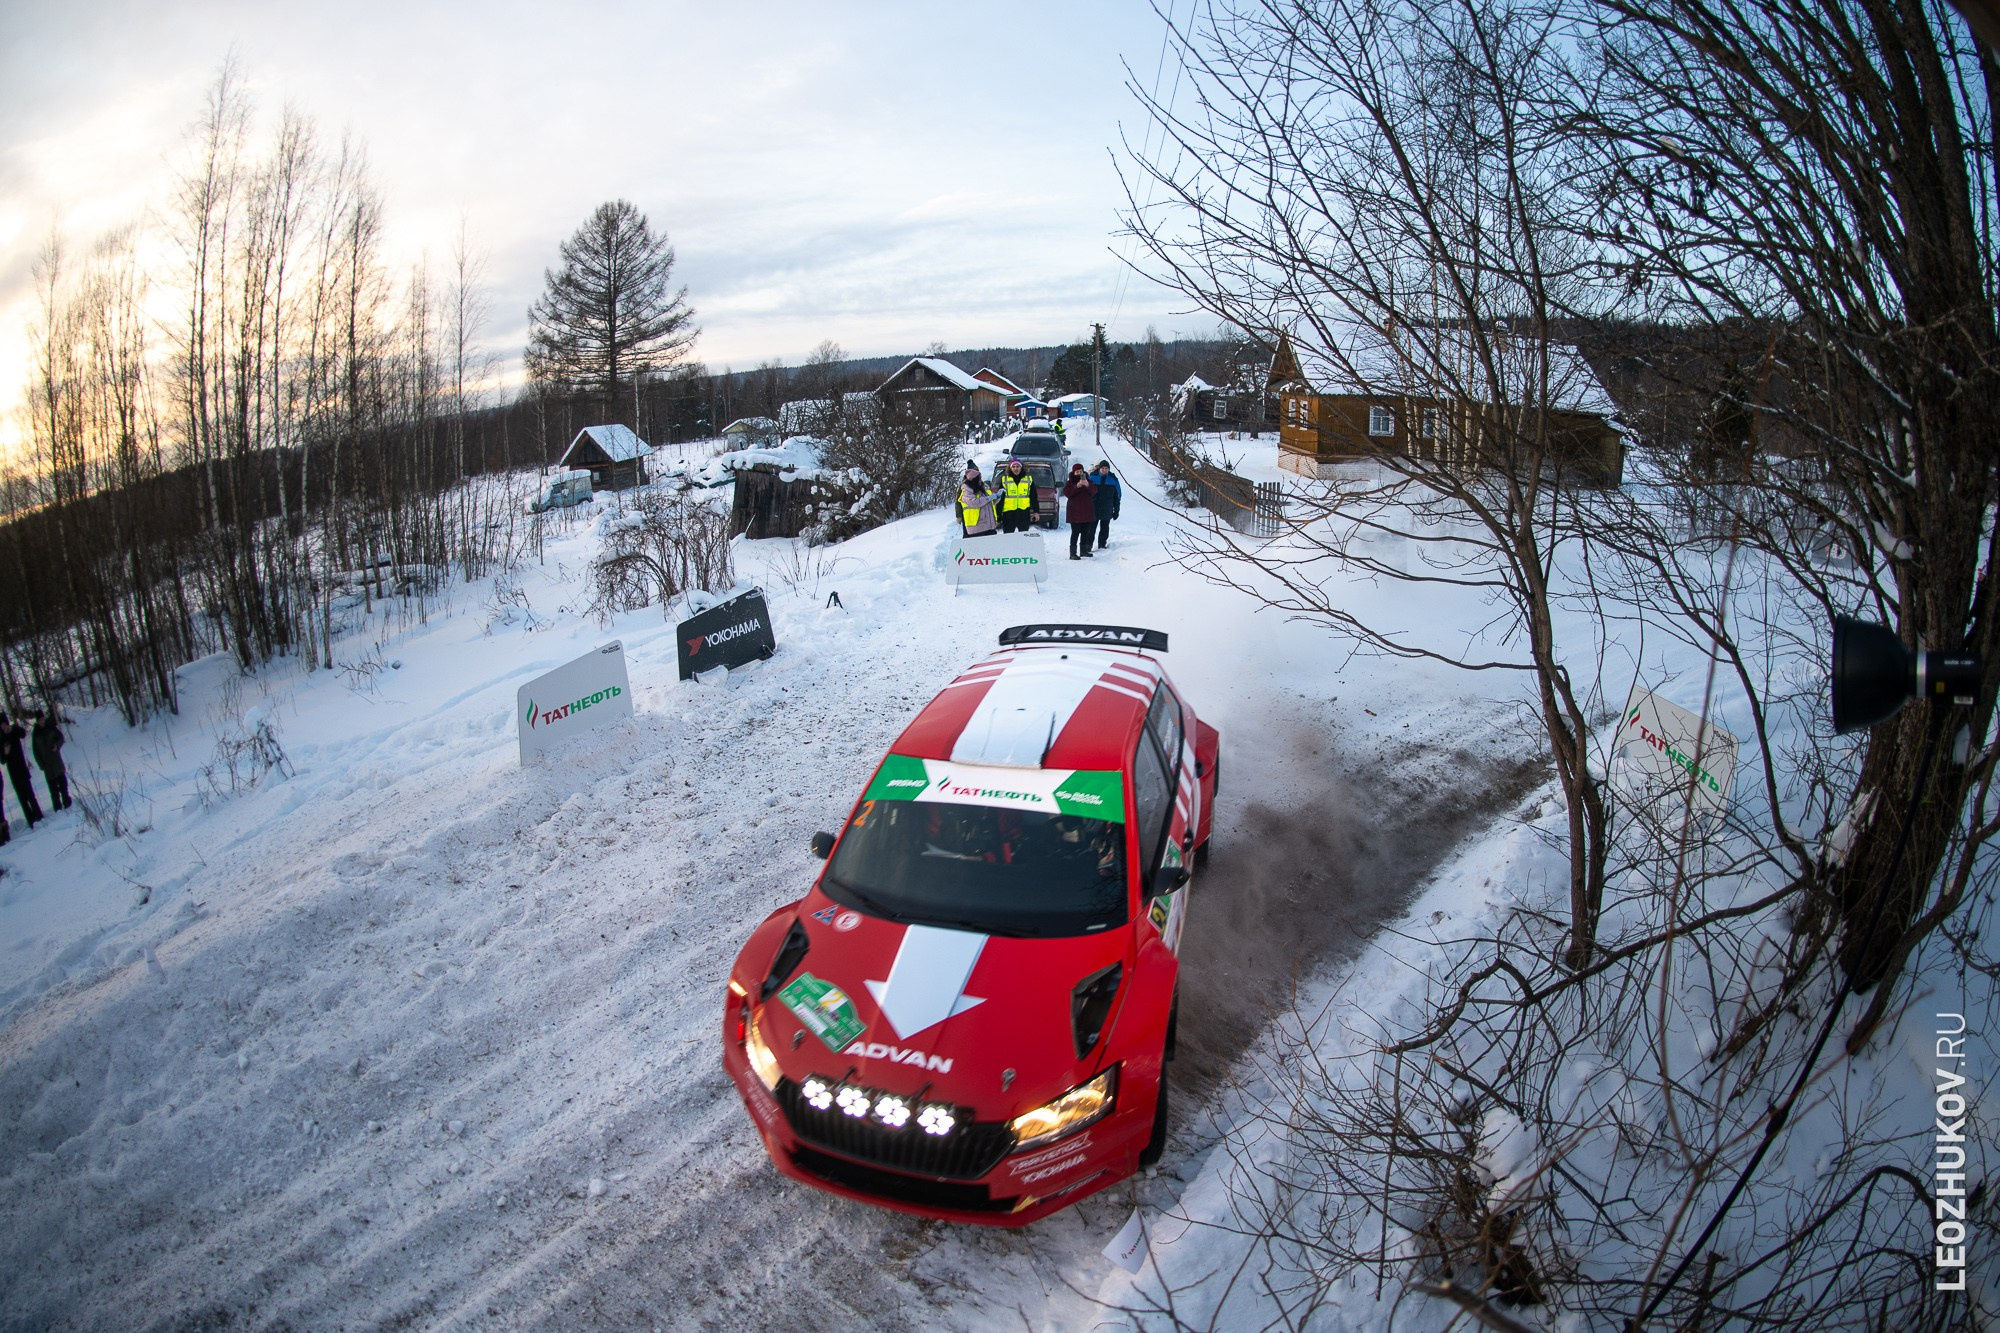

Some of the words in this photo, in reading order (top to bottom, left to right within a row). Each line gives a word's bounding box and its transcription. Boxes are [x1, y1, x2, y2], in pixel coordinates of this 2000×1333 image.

[967, 557, 1038, 566] ТАТНЕФТЬ
[705, 618, 761, 648] YOKOHAMA
[1027, 629, 1144, 642] ADVAN
[541, 685, 621, 726] ТАТНЕФТЬ
[951, 786, 1043, 802] ТАТНЕФТЬ
[853, 799, 876, 827] 2
[820, 990, 844, 1011] 2
[843, 1041, 954, 1074] ADVAN
